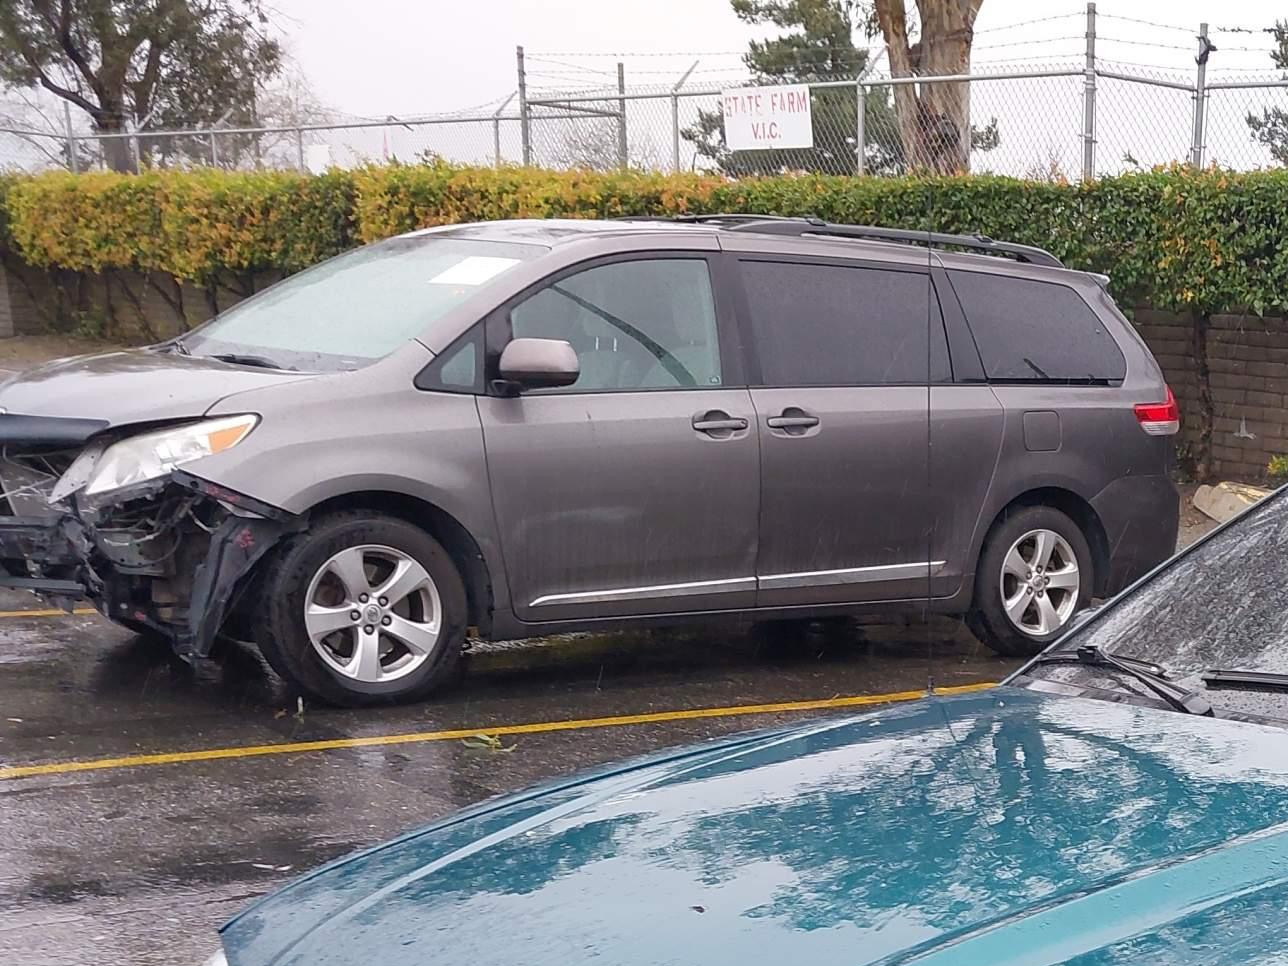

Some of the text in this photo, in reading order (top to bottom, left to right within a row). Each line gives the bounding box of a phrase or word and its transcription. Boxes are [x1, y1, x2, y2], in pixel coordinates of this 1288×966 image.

[724, 91, 808, 117] STATE FARM
[751, 122, 782, 139] V.I.C.
